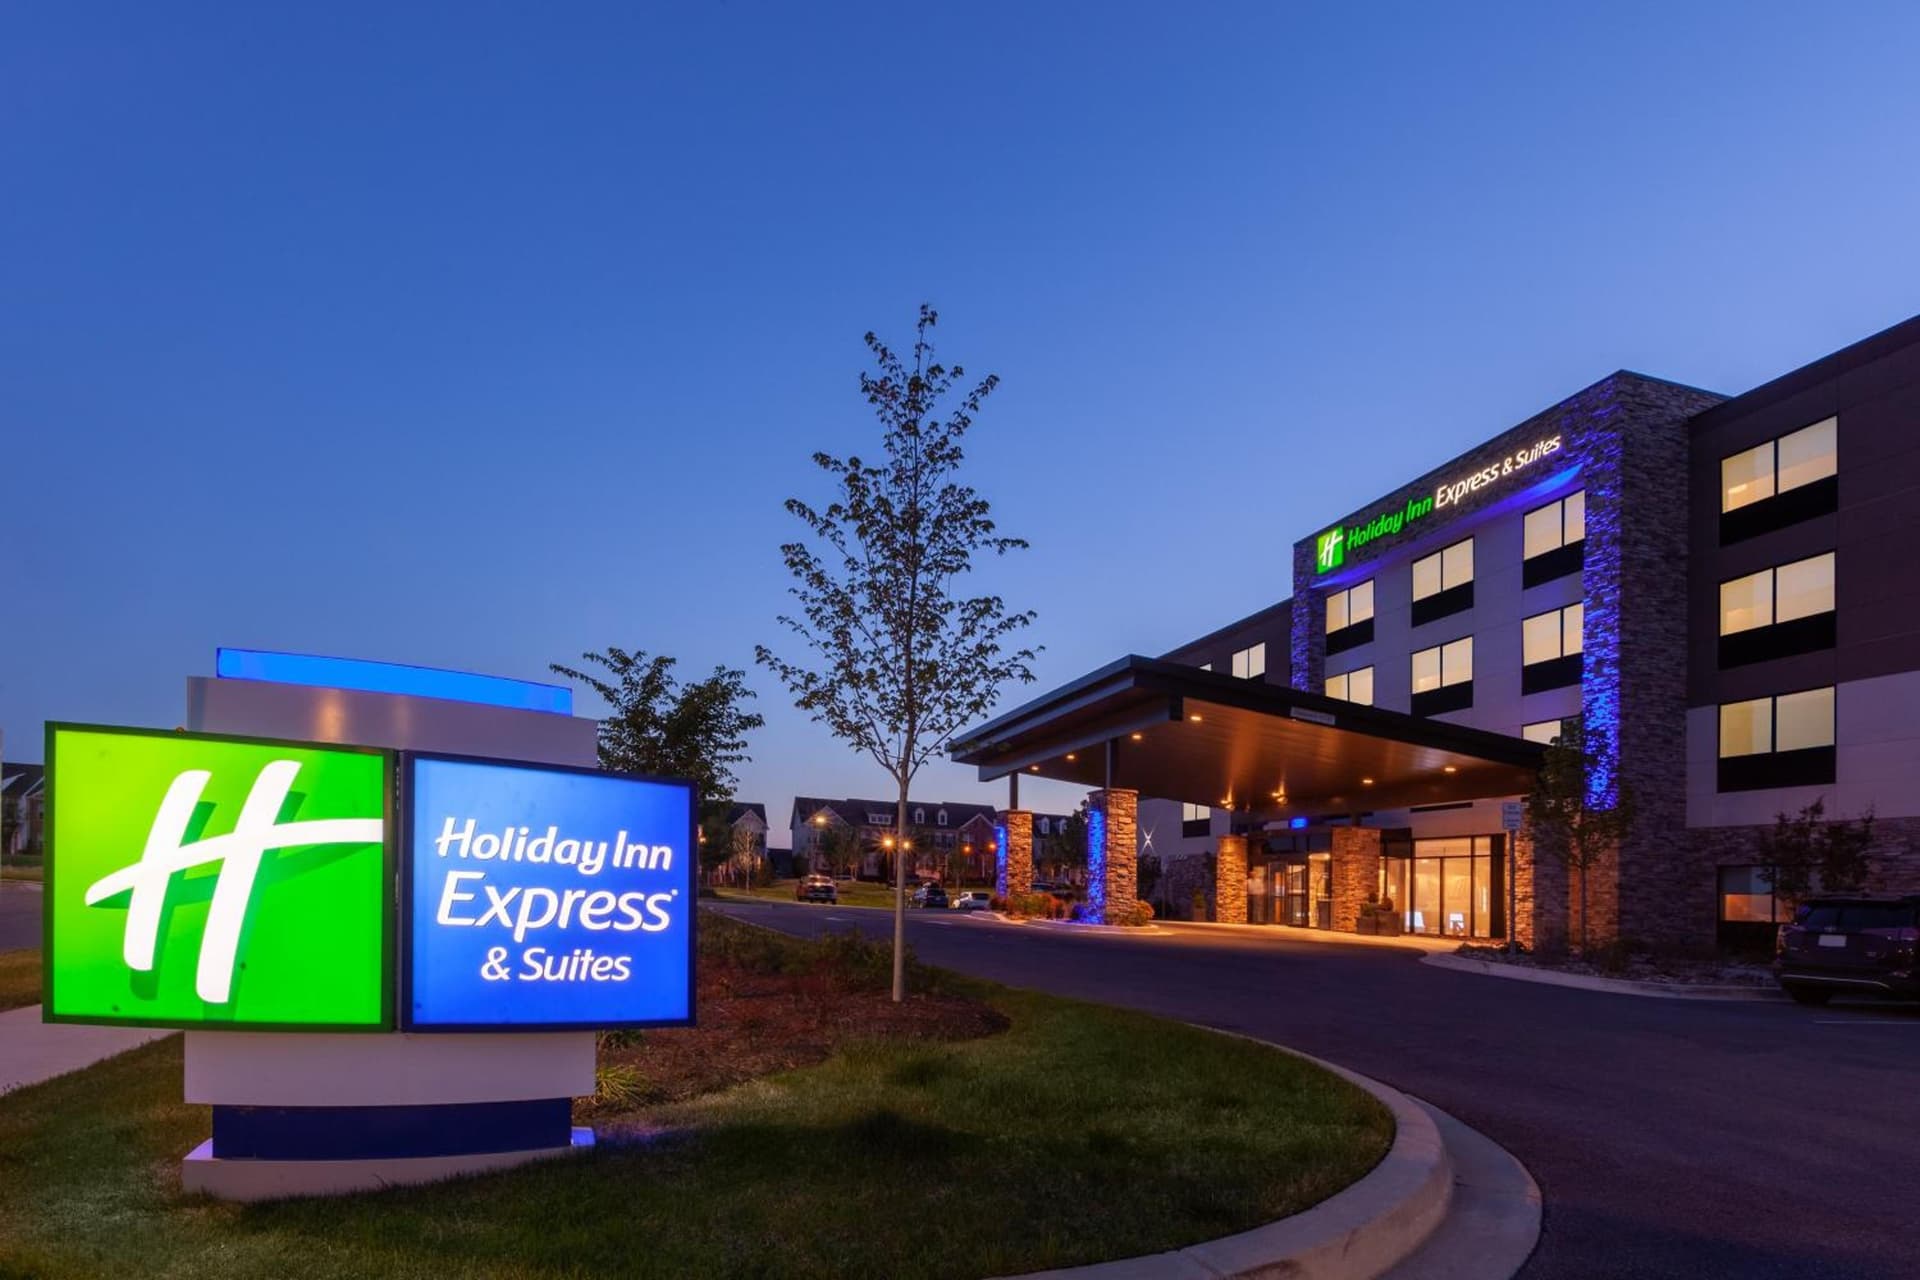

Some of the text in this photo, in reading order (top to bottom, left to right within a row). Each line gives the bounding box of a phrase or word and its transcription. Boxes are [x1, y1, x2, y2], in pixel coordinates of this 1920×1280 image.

[1346, 435, 1562, 551] Holiday Inn Express & Suites
[85, 760, 384, 1004] H
[435, 817, 673, 876] Holiday Inn
[436, 870, 674, 943] Express
[480, 946, 632, 982] & Suites
